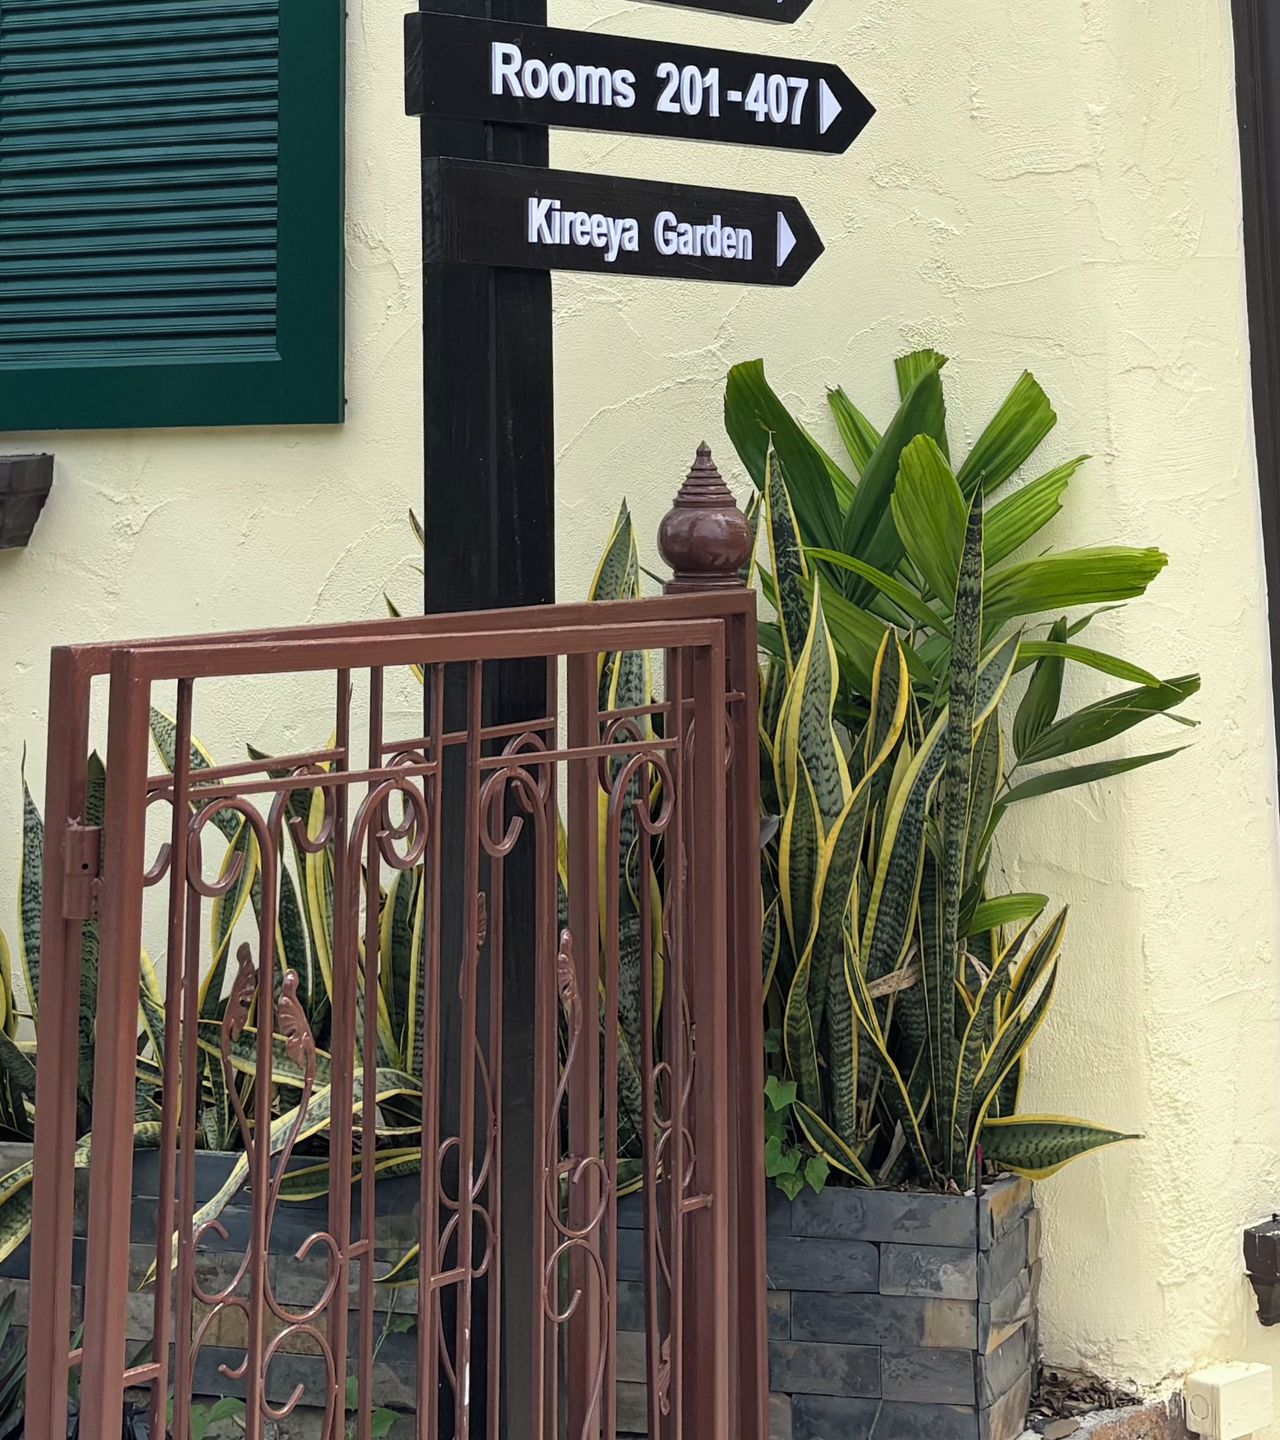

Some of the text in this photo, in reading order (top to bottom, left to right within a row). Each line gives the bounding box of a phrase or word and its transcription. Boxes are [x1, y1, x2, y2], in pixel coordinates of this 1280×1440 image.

[491, 42, 809, 124] Rooms 201-407
[527, 197, 753, 262] Kireeya Garden
